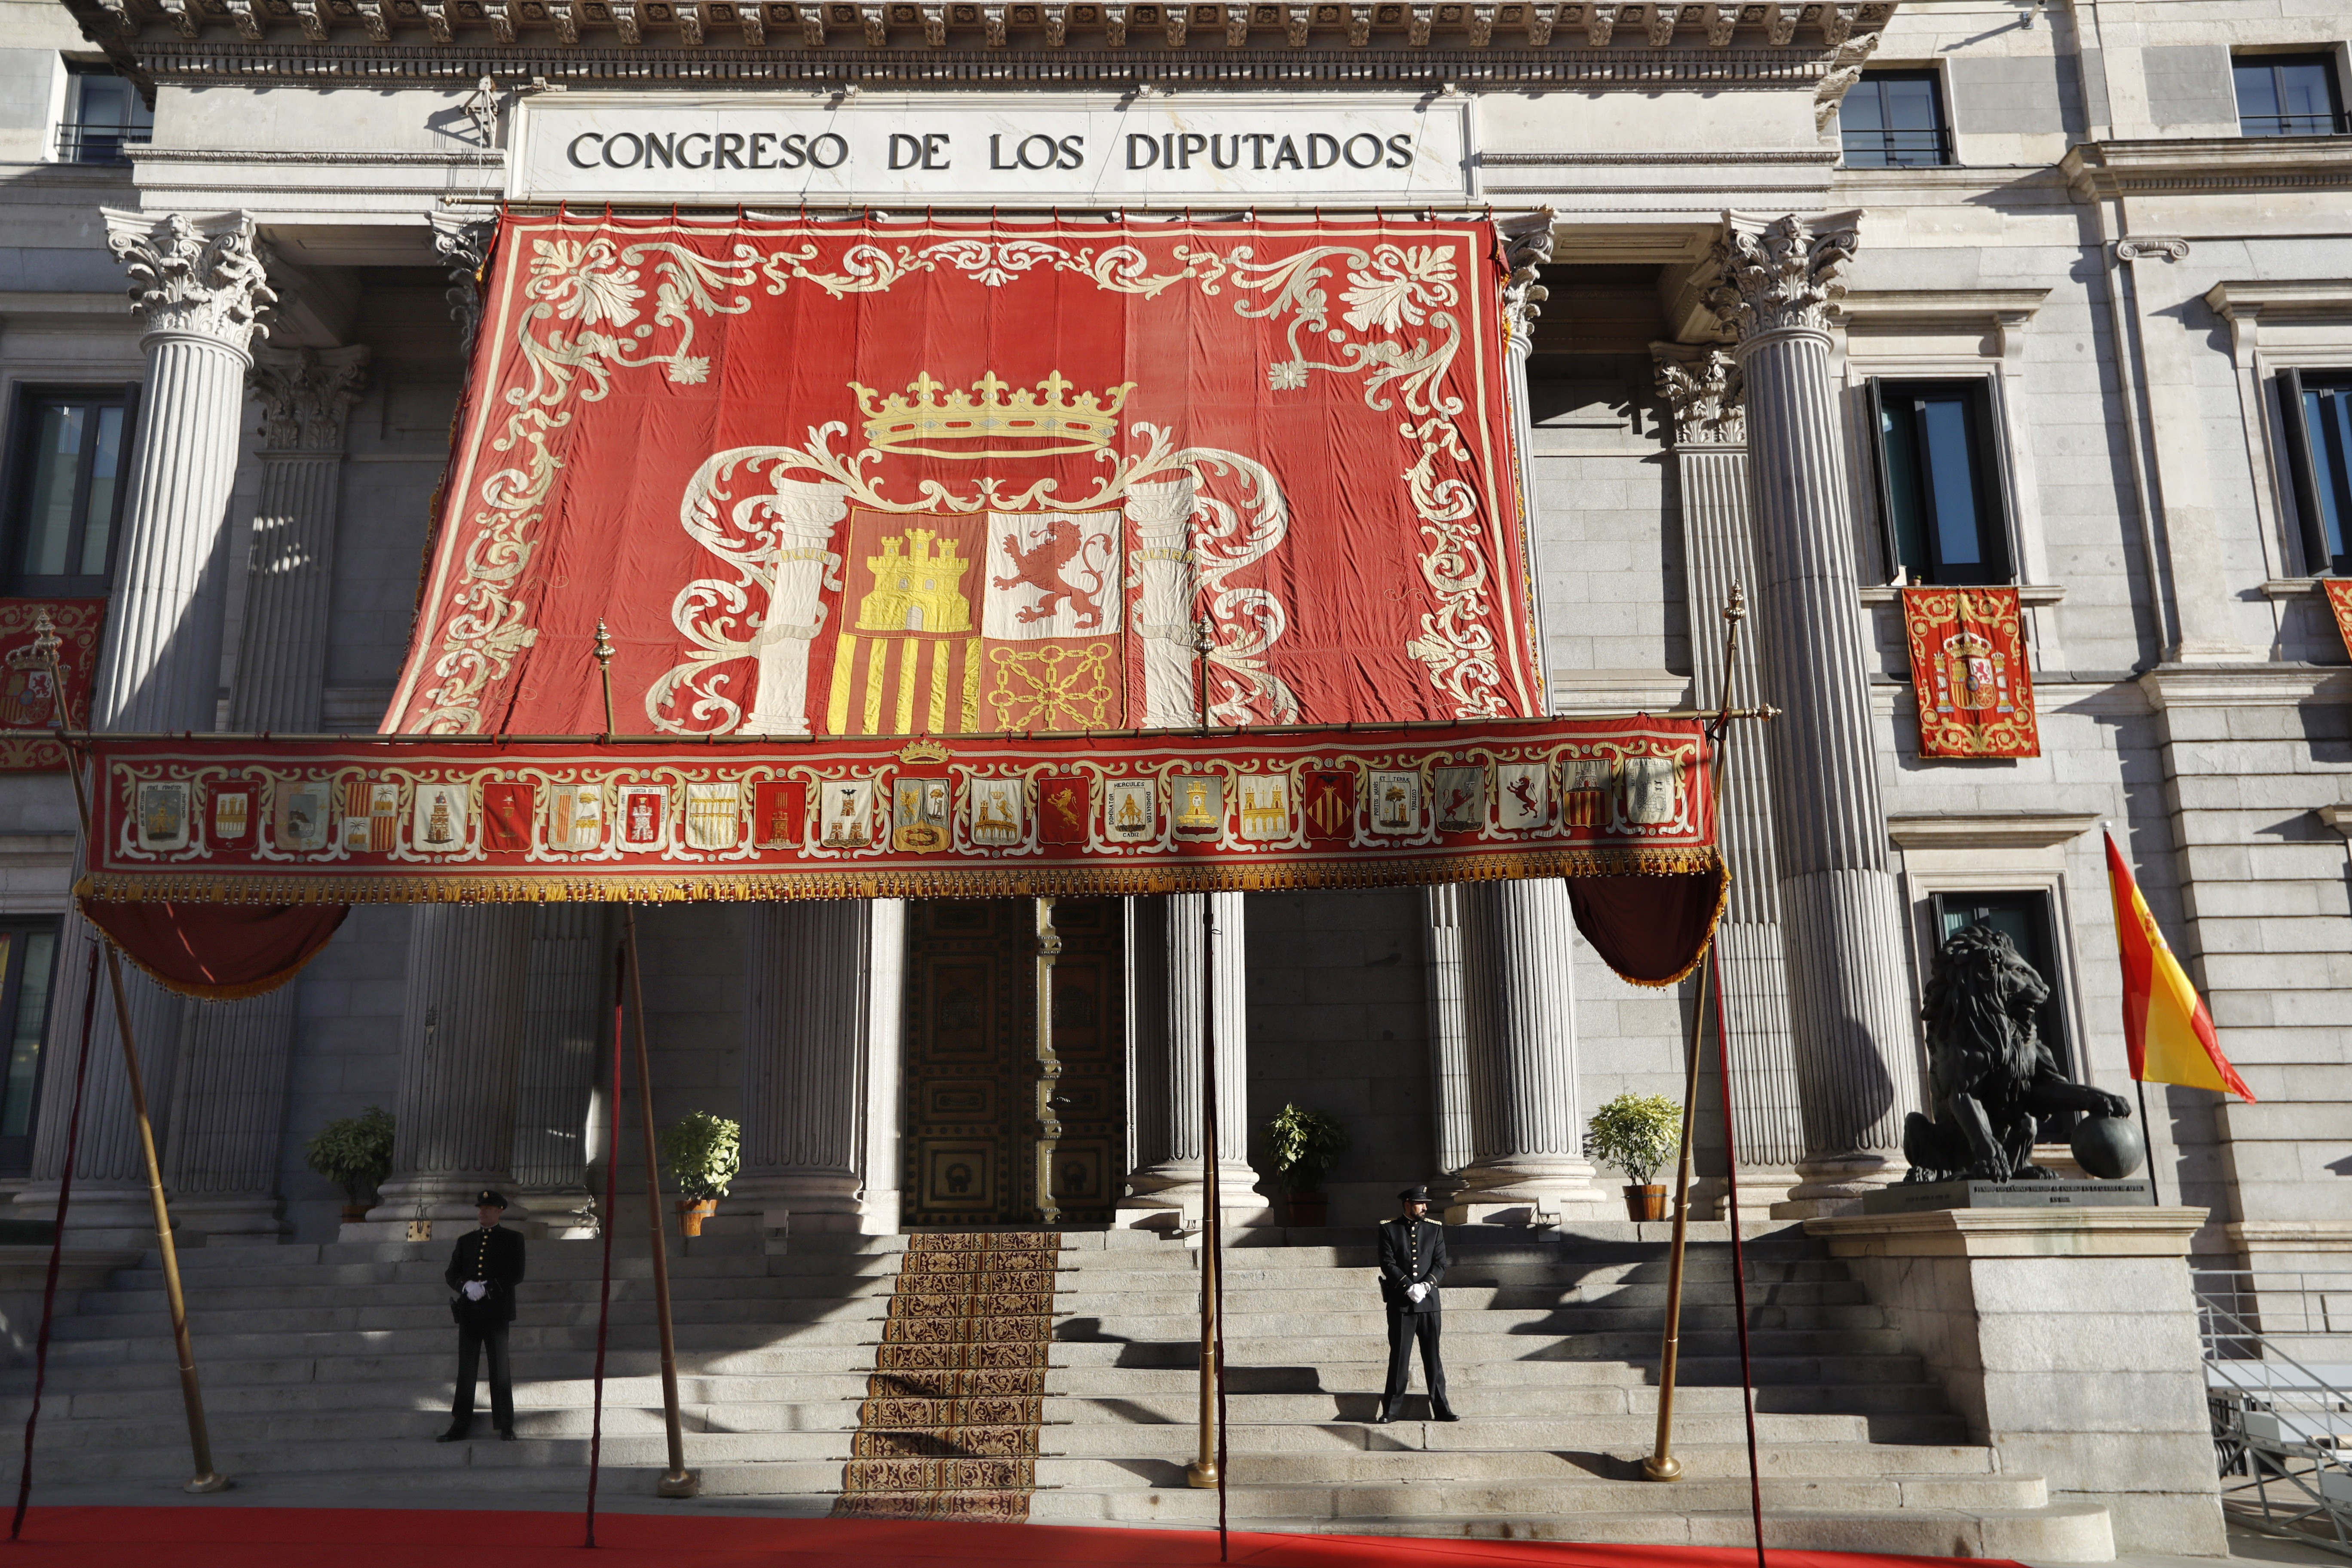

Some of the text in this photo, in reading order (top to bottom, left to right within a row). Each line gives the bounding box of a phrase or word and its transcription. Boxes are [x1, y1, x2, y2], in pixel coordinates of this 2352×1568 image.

[567, 132, 1413, 170] CONGRESO DE LOS DIPUTADOS
[780, 548, 828, 561] PLUS
[1136, 548, 1194, 561] ULTRA
